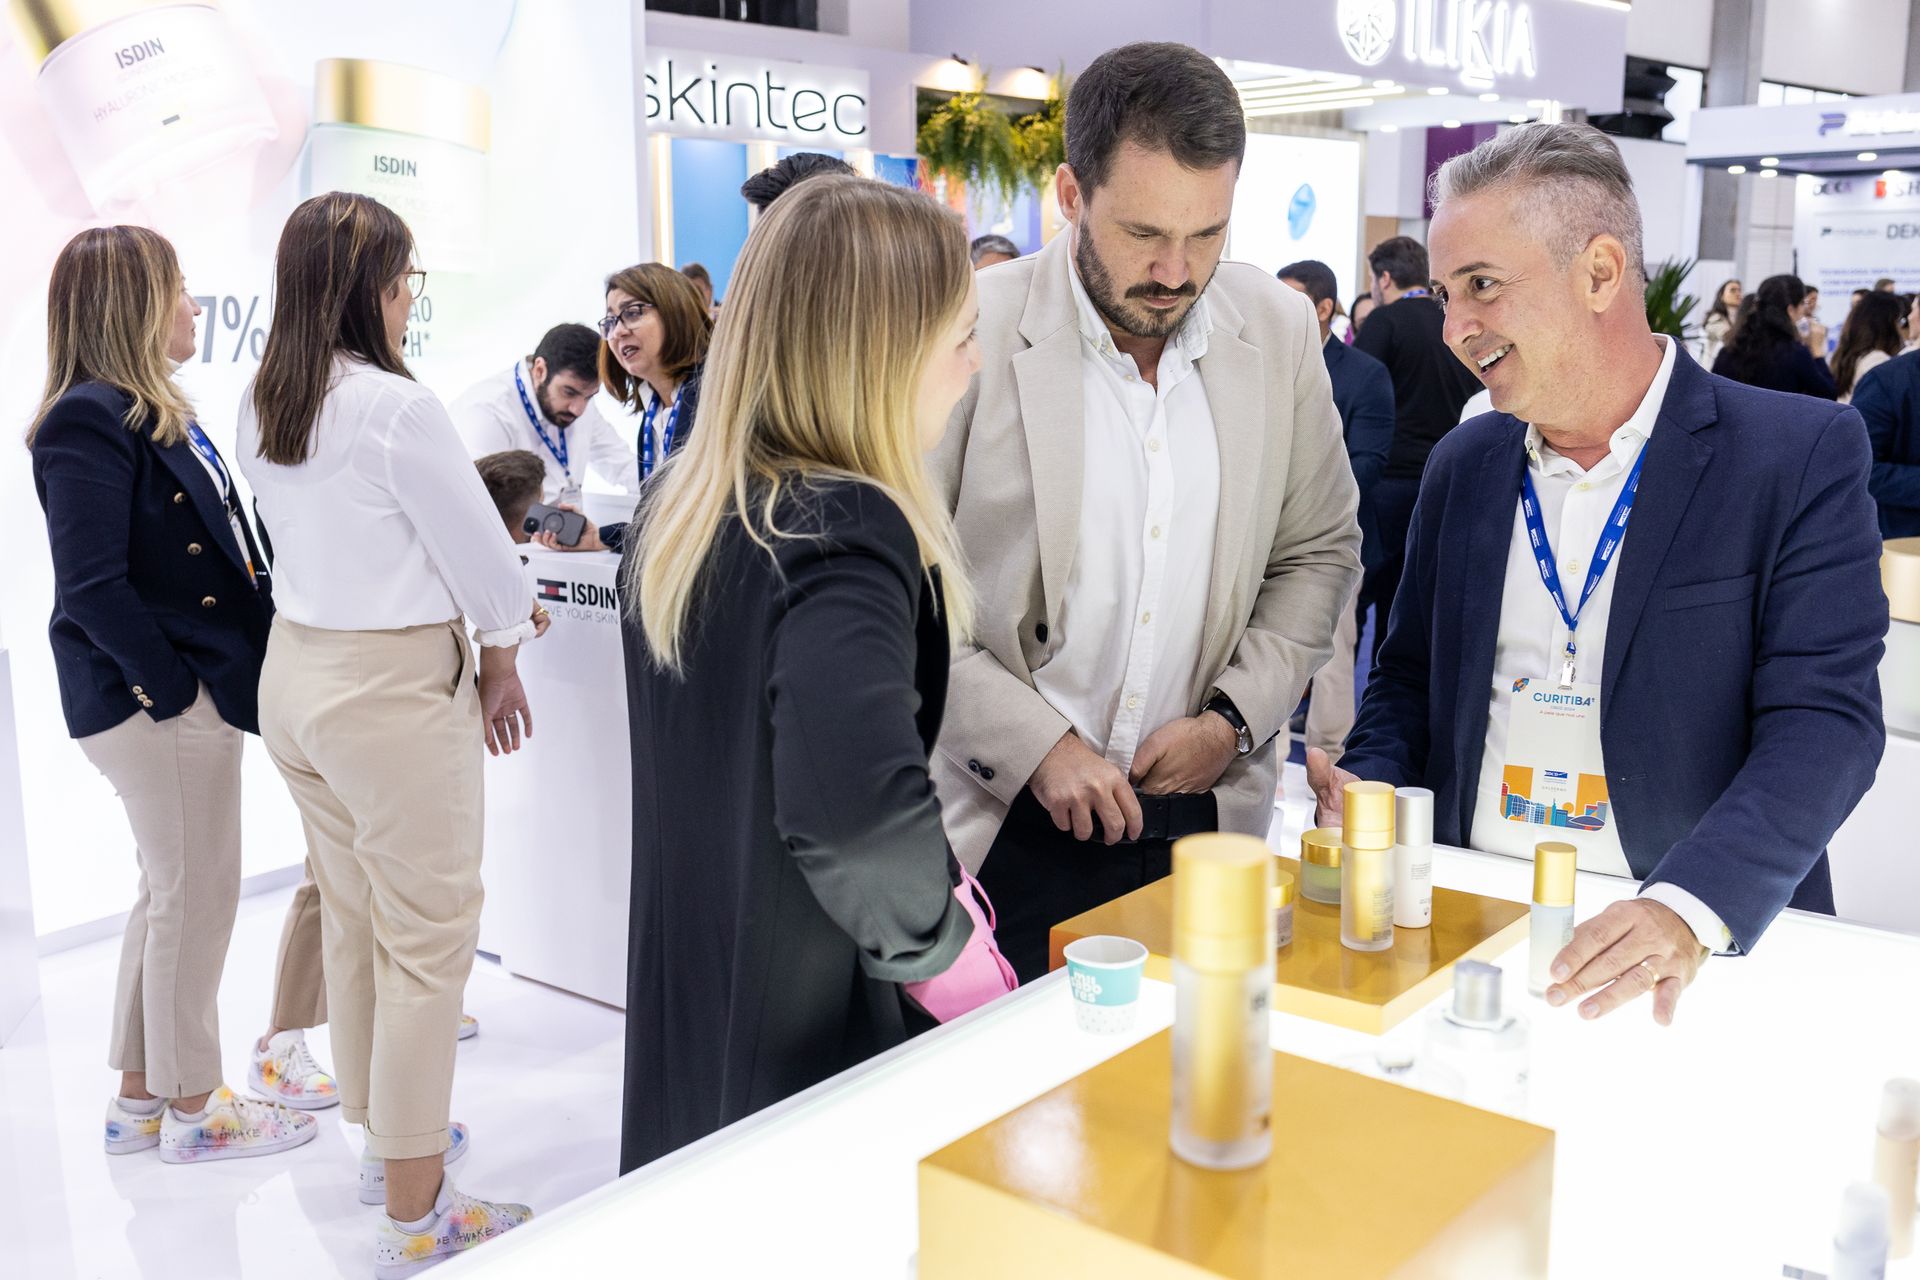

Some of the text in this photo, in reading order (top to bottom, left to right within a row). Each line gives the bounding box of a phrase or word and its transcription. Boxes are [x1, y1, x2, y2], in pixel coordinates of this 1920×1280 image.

[114, 37, 166, 69] ISDIN
[646, 60, 866, 136] skintec
[373, 154, 418, 178] ISDIN
[571, 582, 616, 611] ISDIN
[565, 607, 592, 621] YOUR
[594, 611, 619, 625] SKIN
[1533, 692, 1592, 706] CURITIBA
